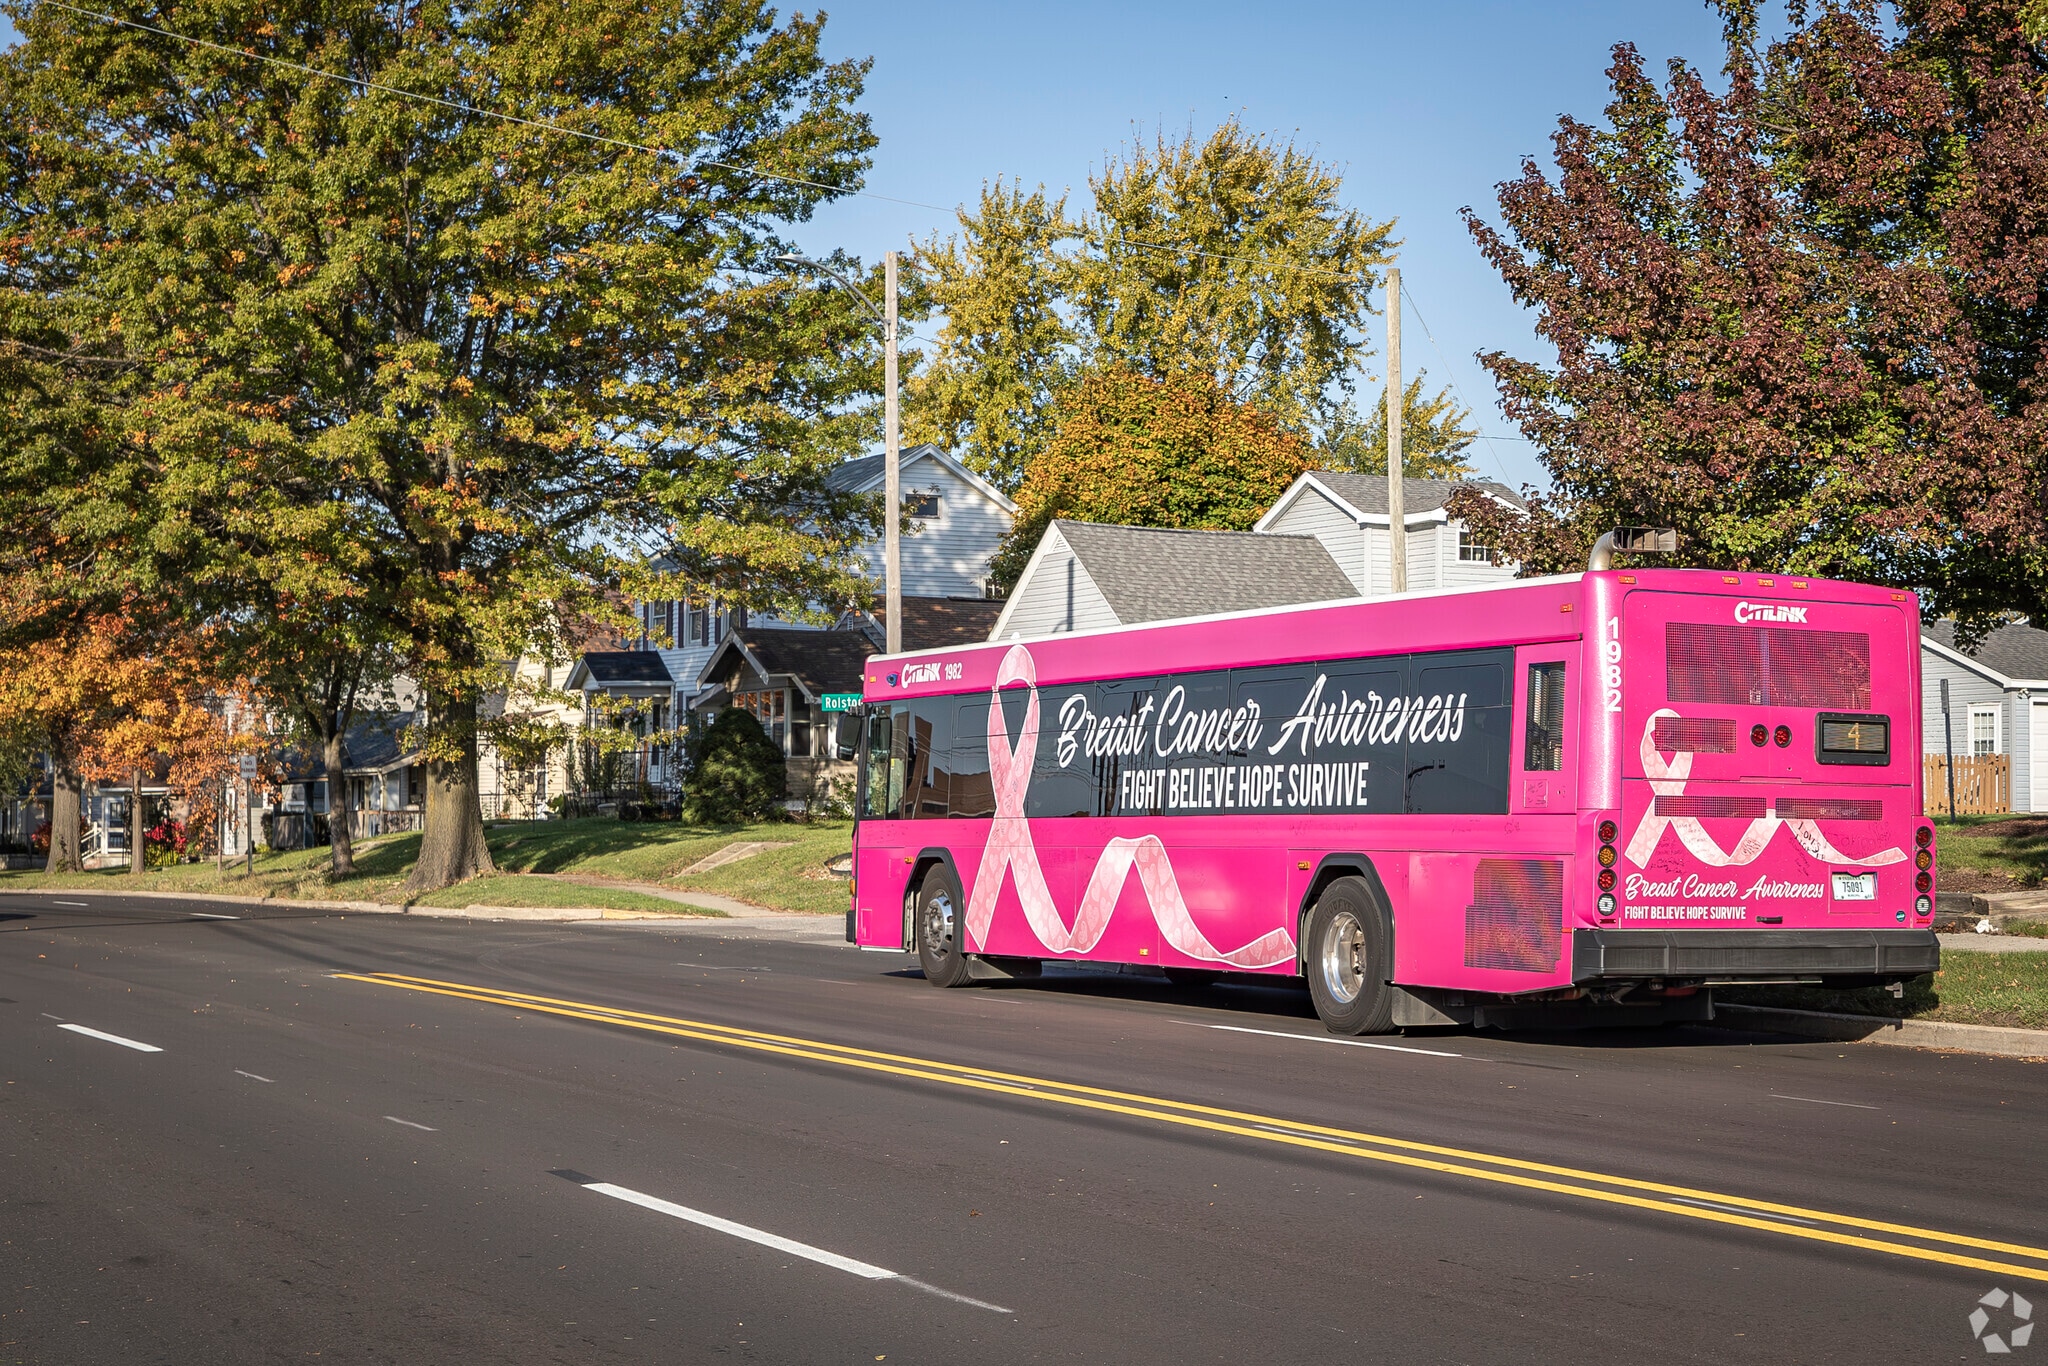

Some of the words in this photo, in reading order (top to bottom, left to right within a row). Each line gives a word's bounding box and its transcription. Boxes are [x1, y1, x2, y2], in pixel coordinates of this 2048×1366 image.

[1734, 601, 1808, 624] CITILINK
[901, 663, 941, 688] CITILINK
[944, 662, 963, 681] 1982
[1607, 616, 1622, 712] 1982
[1057, 693, 1155, 769] Breast
[1154, 684, 1264, 758] Cancer
[1267, 673, 1468, 757] Awareness
[1847, 722, 1861, 750] 4
[1120, 769, 1166, 810] FIGHT
[1168, 766, 1237, 809] BELIEVE
[1238, 764, 1283, 808] HOPE
[1287, 762, 1370, 807] SURVIVE
[1625, 873, 1682, 900] Breast
[1682, 873, 1739, 899] Cancer
[1740, 874, 1825, 901] Awareness
[1842, 881, 1864, 893] 75091
[1624, 905, 1649, 920] FIGHT
[1650, 906, 1686, 920] BELIEVE
[1686, 906, 1709, 920] HOPE
[1709, 906, 1747, 920] SURVIVE
